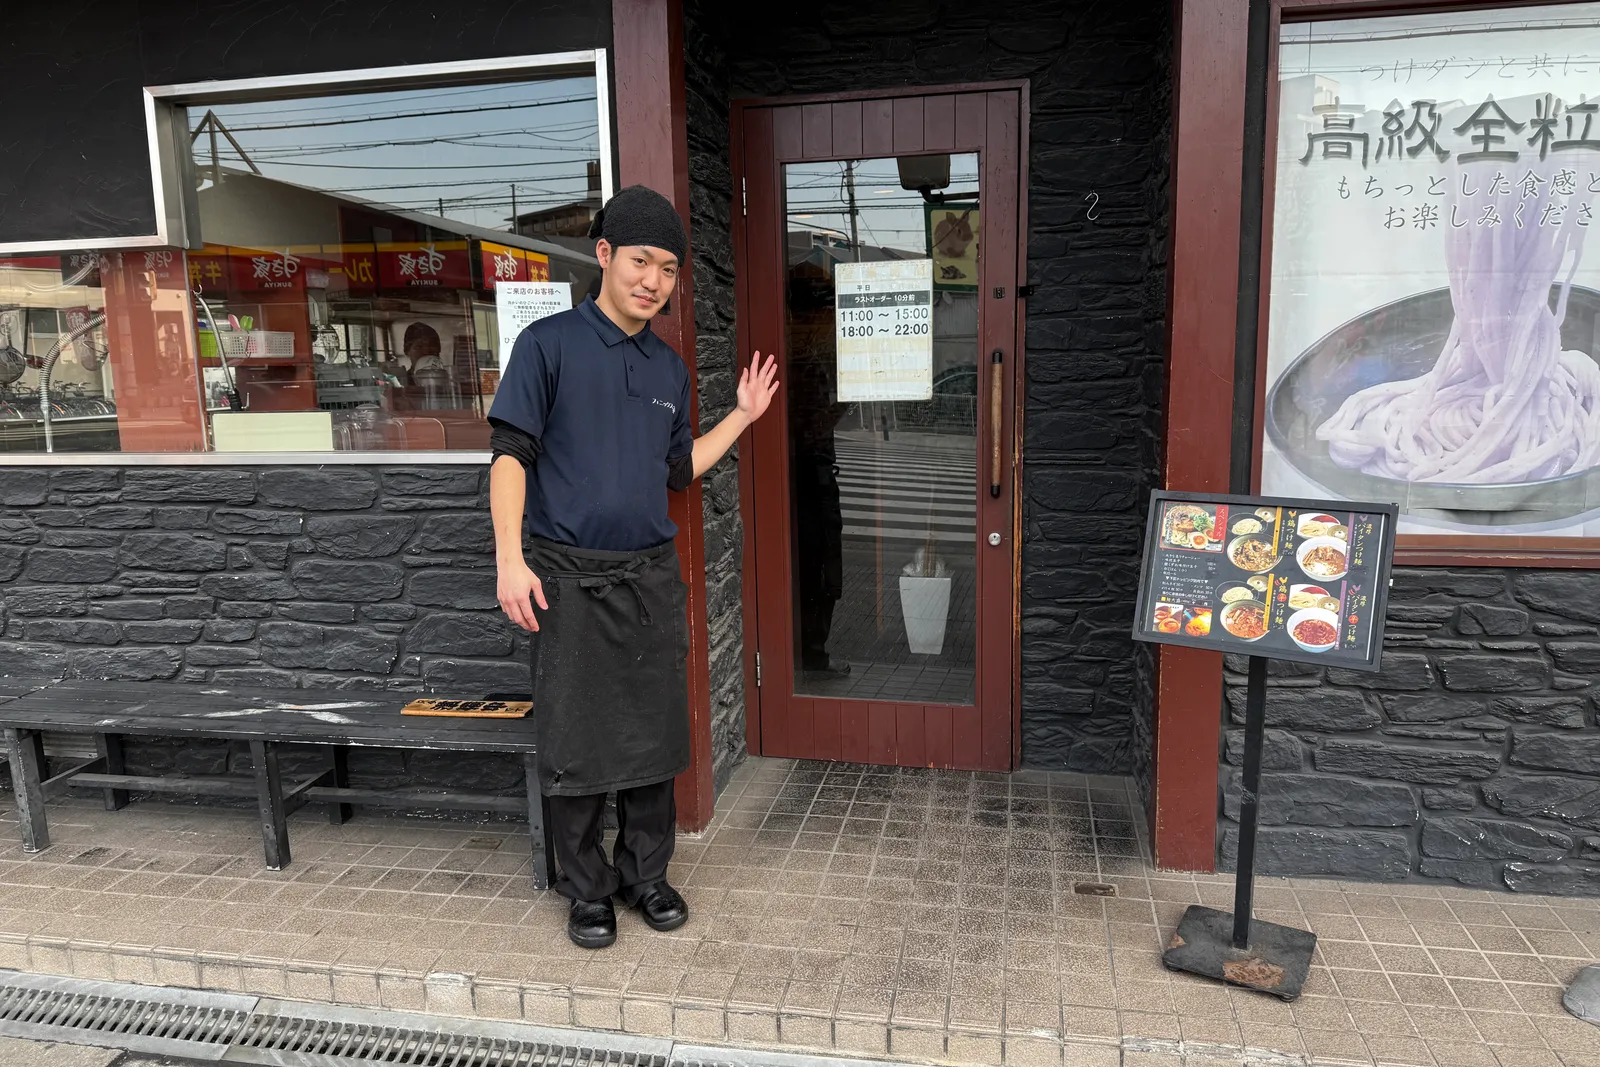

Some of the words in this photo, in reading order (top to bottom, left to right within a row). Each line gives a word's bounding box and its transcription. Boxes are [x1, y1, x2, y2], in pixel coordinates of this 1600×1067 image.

[1361, 53, 1600, 84] つけダシと共に
[507, 287, 561, 295] ご来店のお客様へ
[894, 294, 916, 302] 10分前
[841, 310, 874, 322] 11:00
[895, 308, 929, 320] 15:00
[841, 325, 874, 337] 18:00
[895, 323, 929, 336] 22:00
